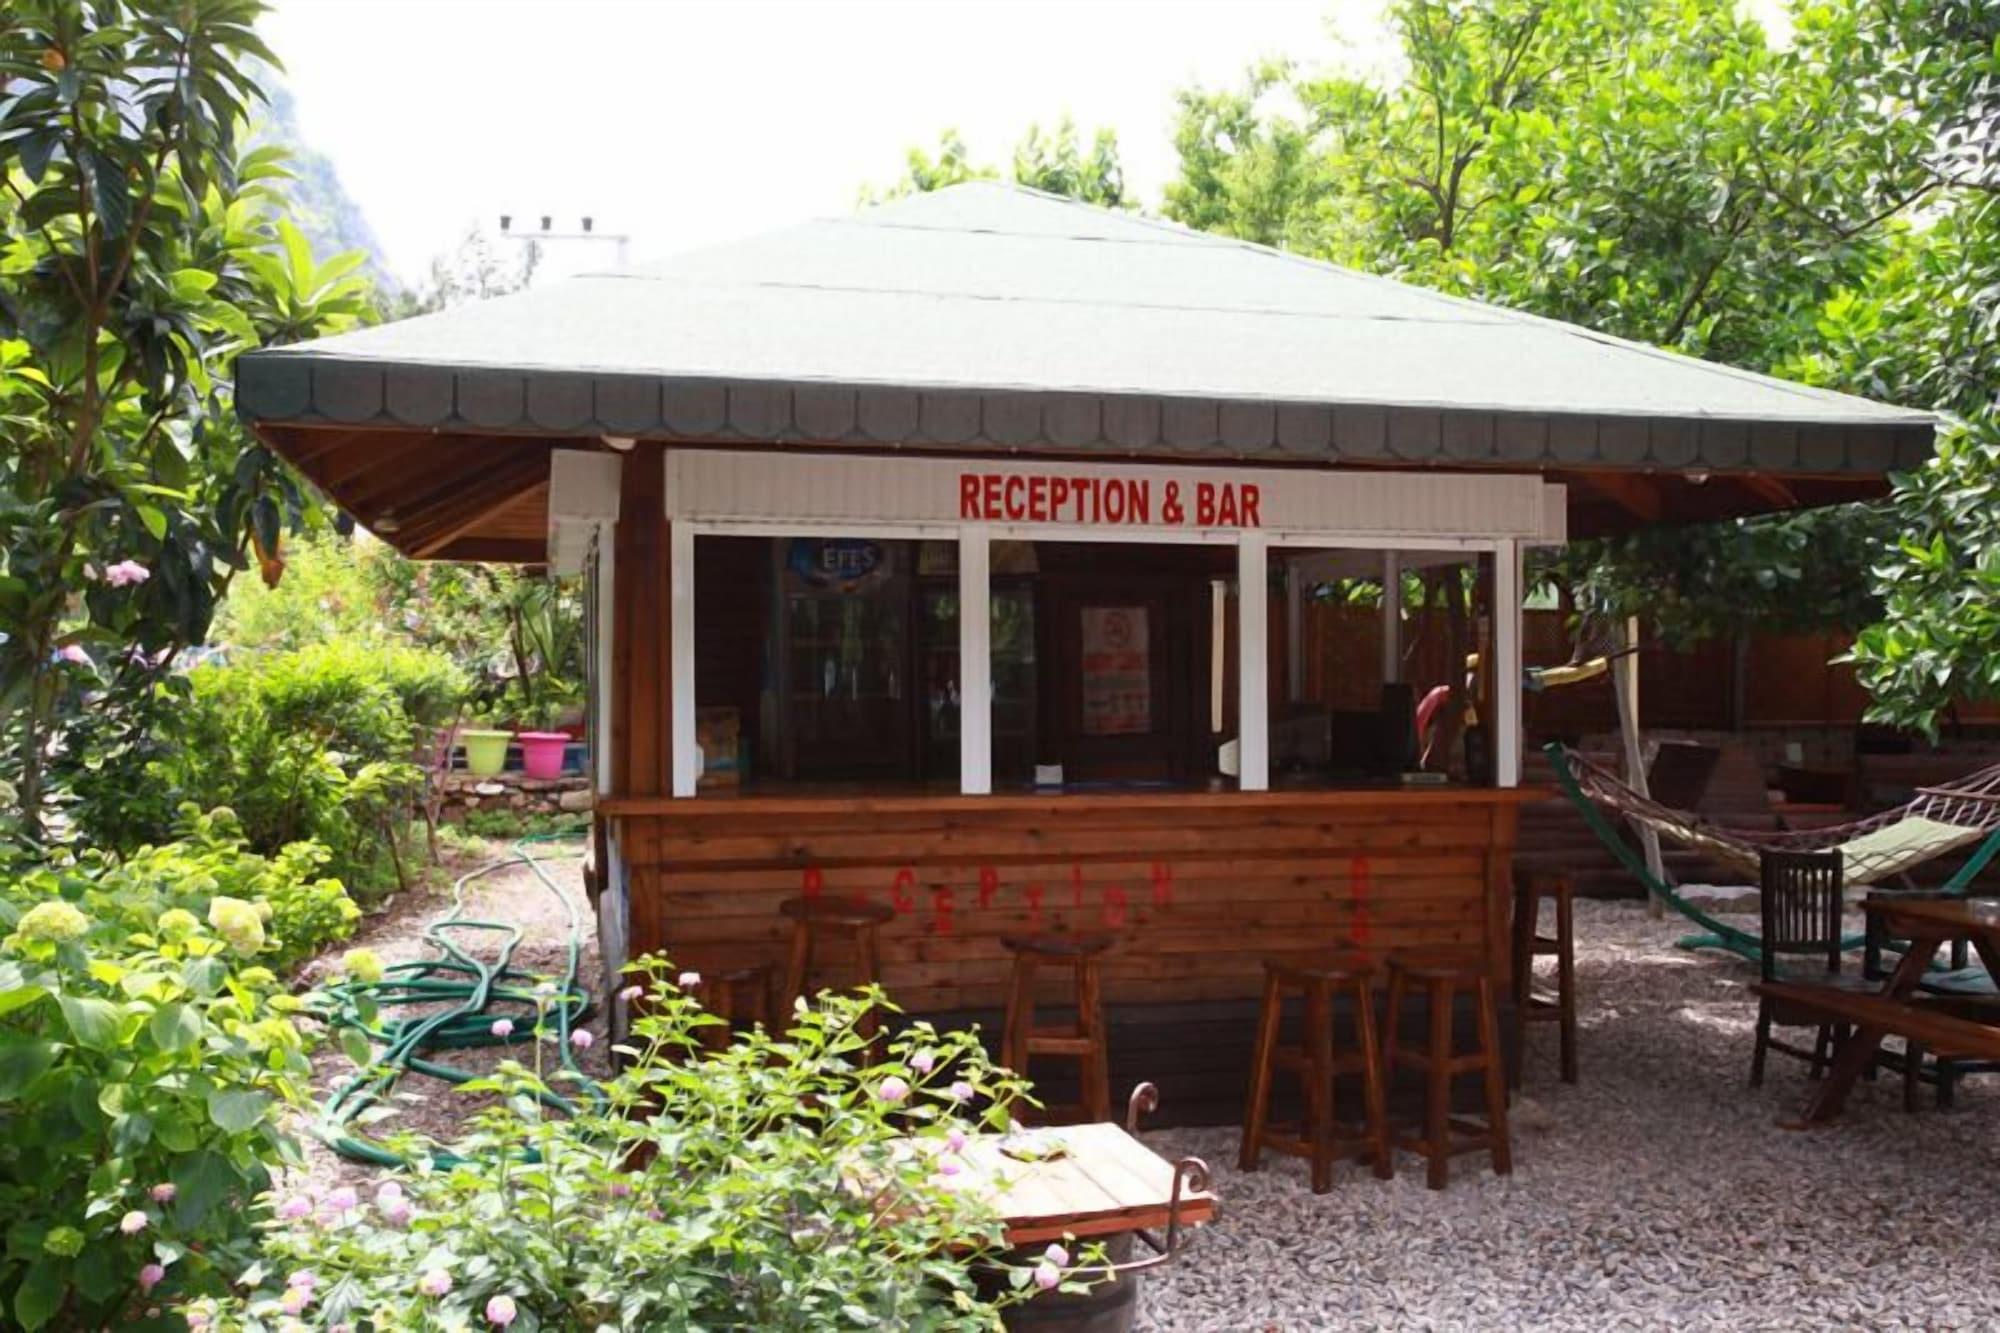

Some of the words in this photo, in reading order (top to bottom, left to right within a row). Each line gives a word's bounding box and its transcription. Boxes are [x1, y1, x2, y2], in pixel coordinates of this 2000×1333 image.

[960, 474, 1150, 523] RECEPTION
[1162, 480, 1185, 525] &
[1197, 482, 1261, 527] BAR
